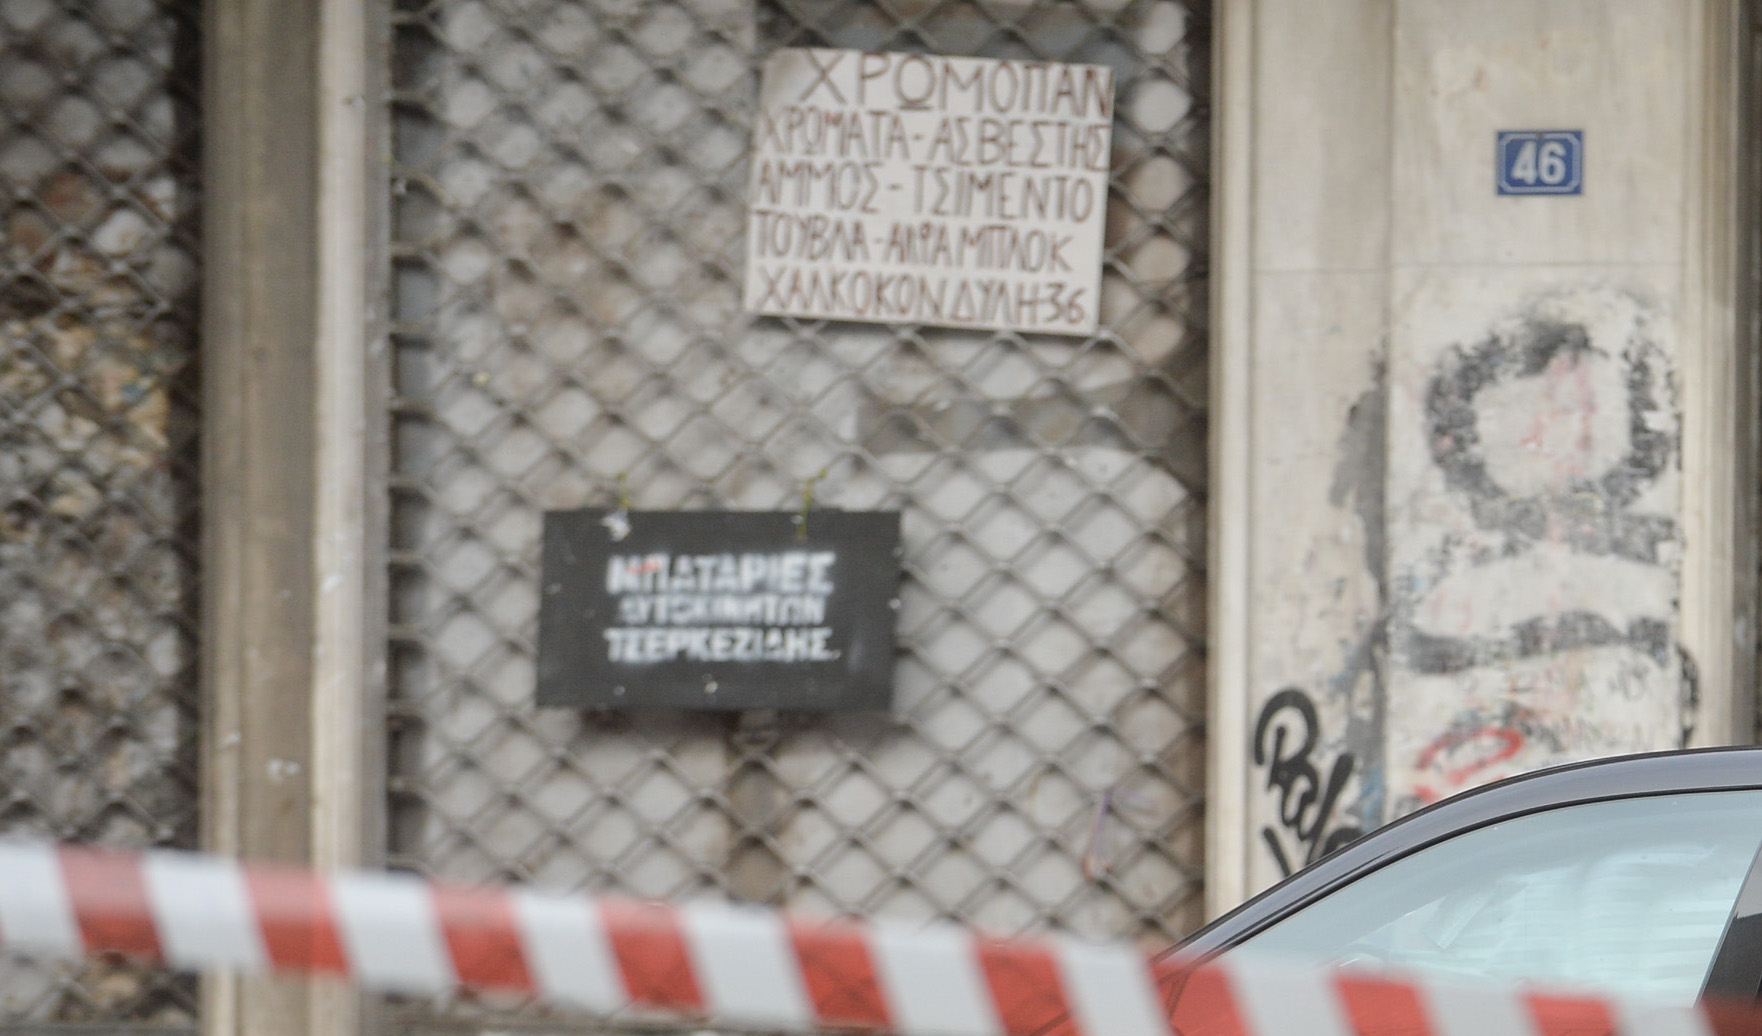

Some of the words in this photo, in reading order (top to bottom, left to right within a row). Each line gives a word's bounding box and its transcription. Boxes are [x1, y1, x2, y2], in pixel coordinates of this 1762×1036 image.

[799, 51, 1115, 117] ΧΡΩΜΟΠΑΝ
[1510, 140, 1567, 186] 46
[757, 160, 884, 214] ΑΜΜΟΣ
[912, 165, 1095, 223] ΤΣΙΜΕΝΤΟ
[606, 552, 836, 594] ΜΠΑΤΑΡΙΕΣ
